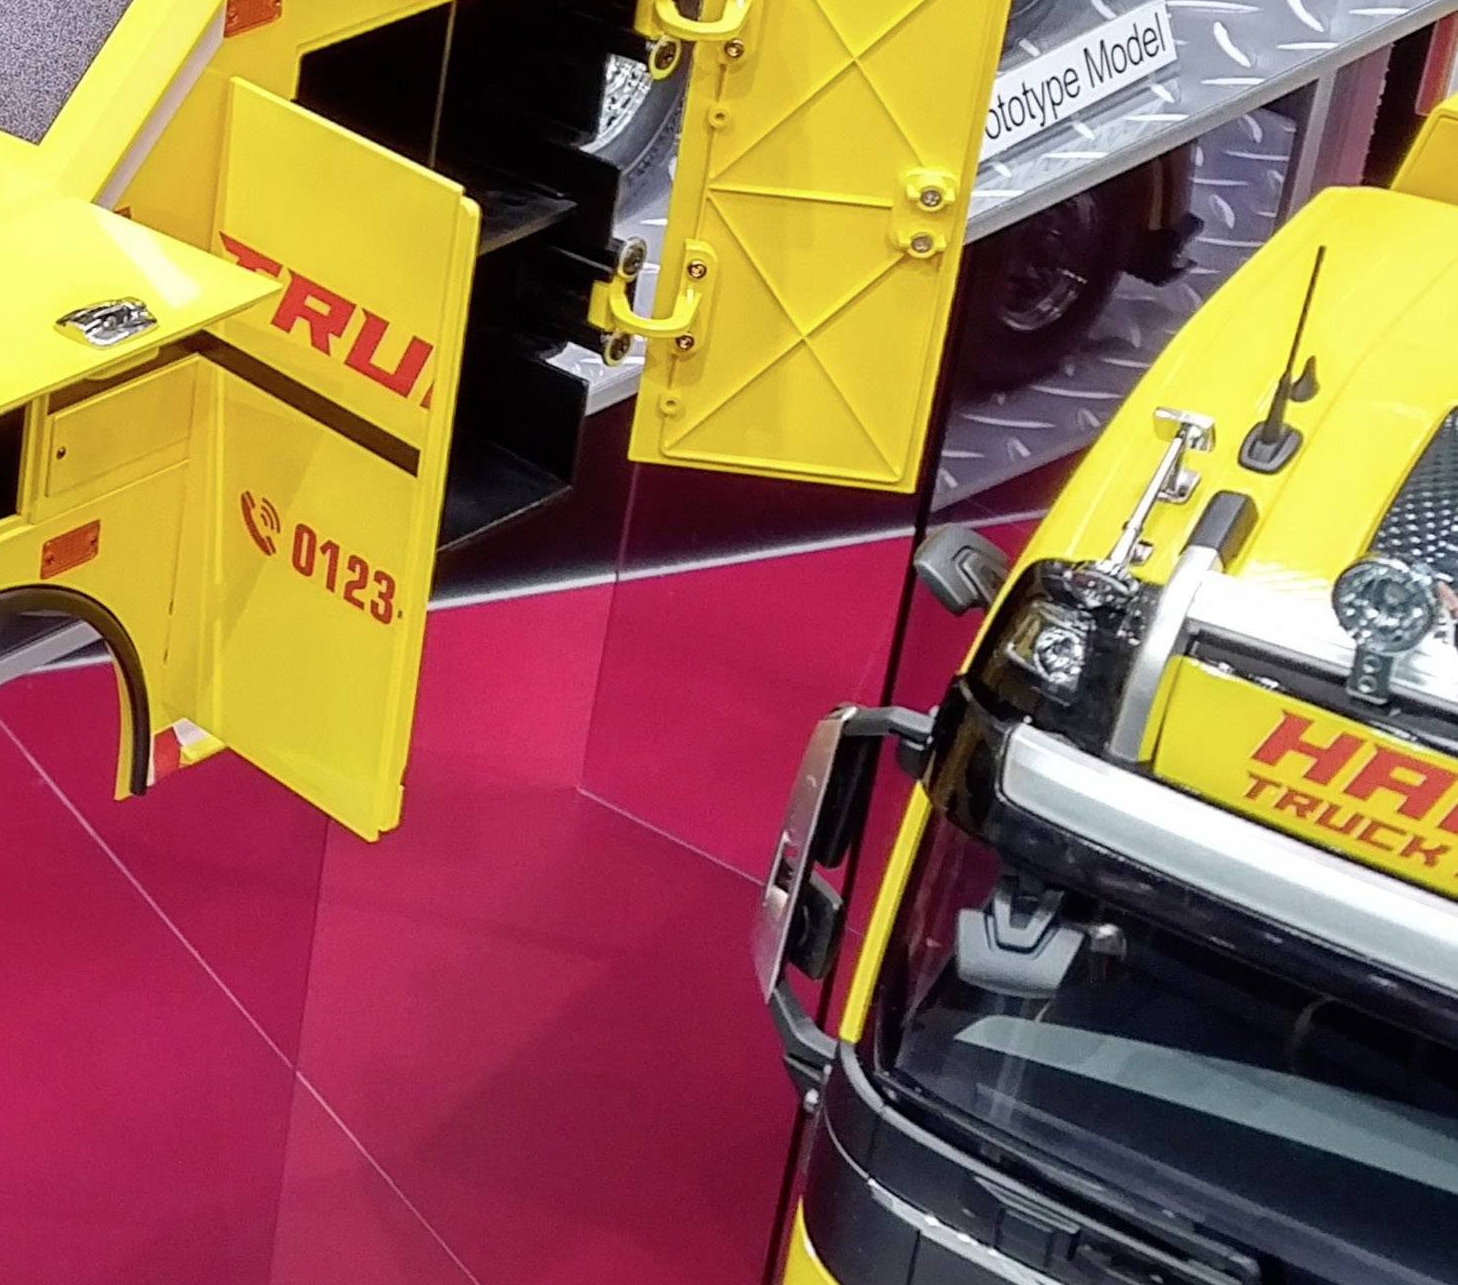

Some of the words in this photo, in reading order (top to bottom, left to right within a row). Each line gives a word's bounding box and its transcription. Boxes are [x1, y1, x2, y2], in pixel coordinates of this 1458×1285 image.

[1084, 12, 1166, 89] Model
[218, 230, 434, 409] TRU
[1244, 771, 1451, 867] TRUCK
[1250, 710, 1458, 834] HA
